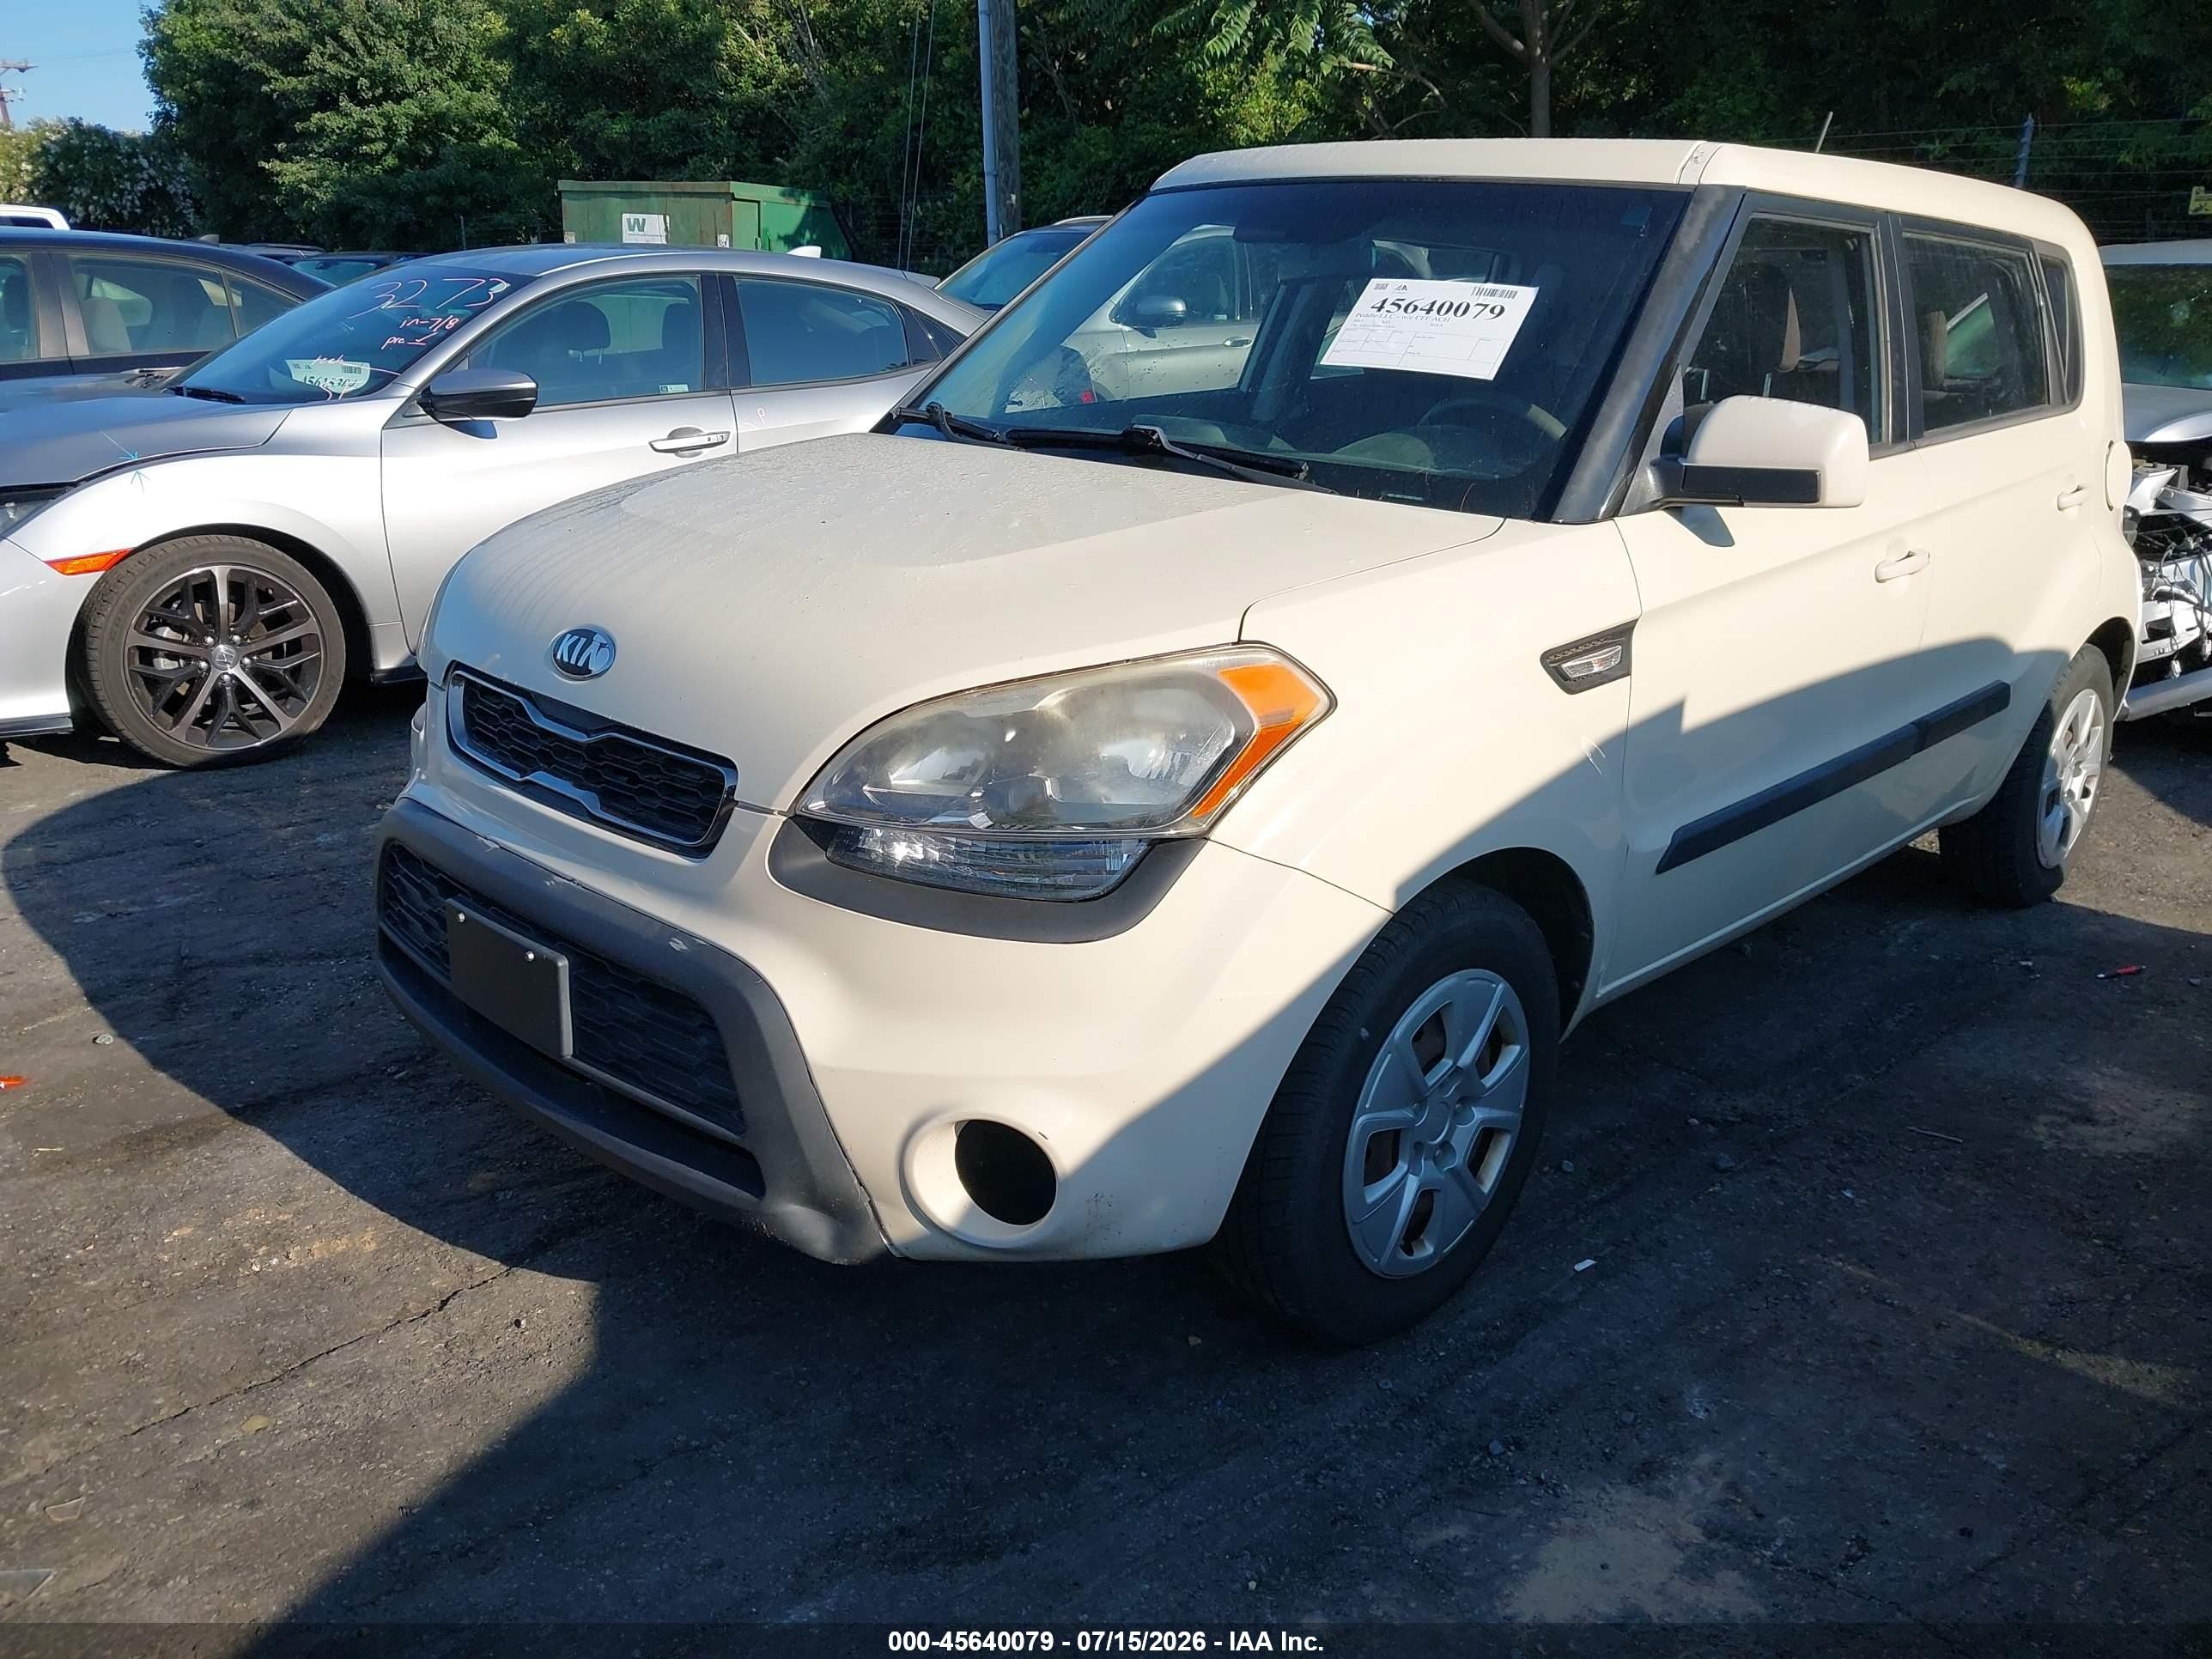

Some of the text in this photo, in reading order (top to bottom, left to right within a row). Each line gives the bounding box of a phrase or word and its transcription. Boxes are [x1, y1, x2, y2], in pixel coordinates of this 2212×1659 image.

[626, 217, 647, 233] W
[347, 277, 507, 319] 3273
[1370, 297, 1505, 320] 45640079
[556, 632, 604, 672] KIA
